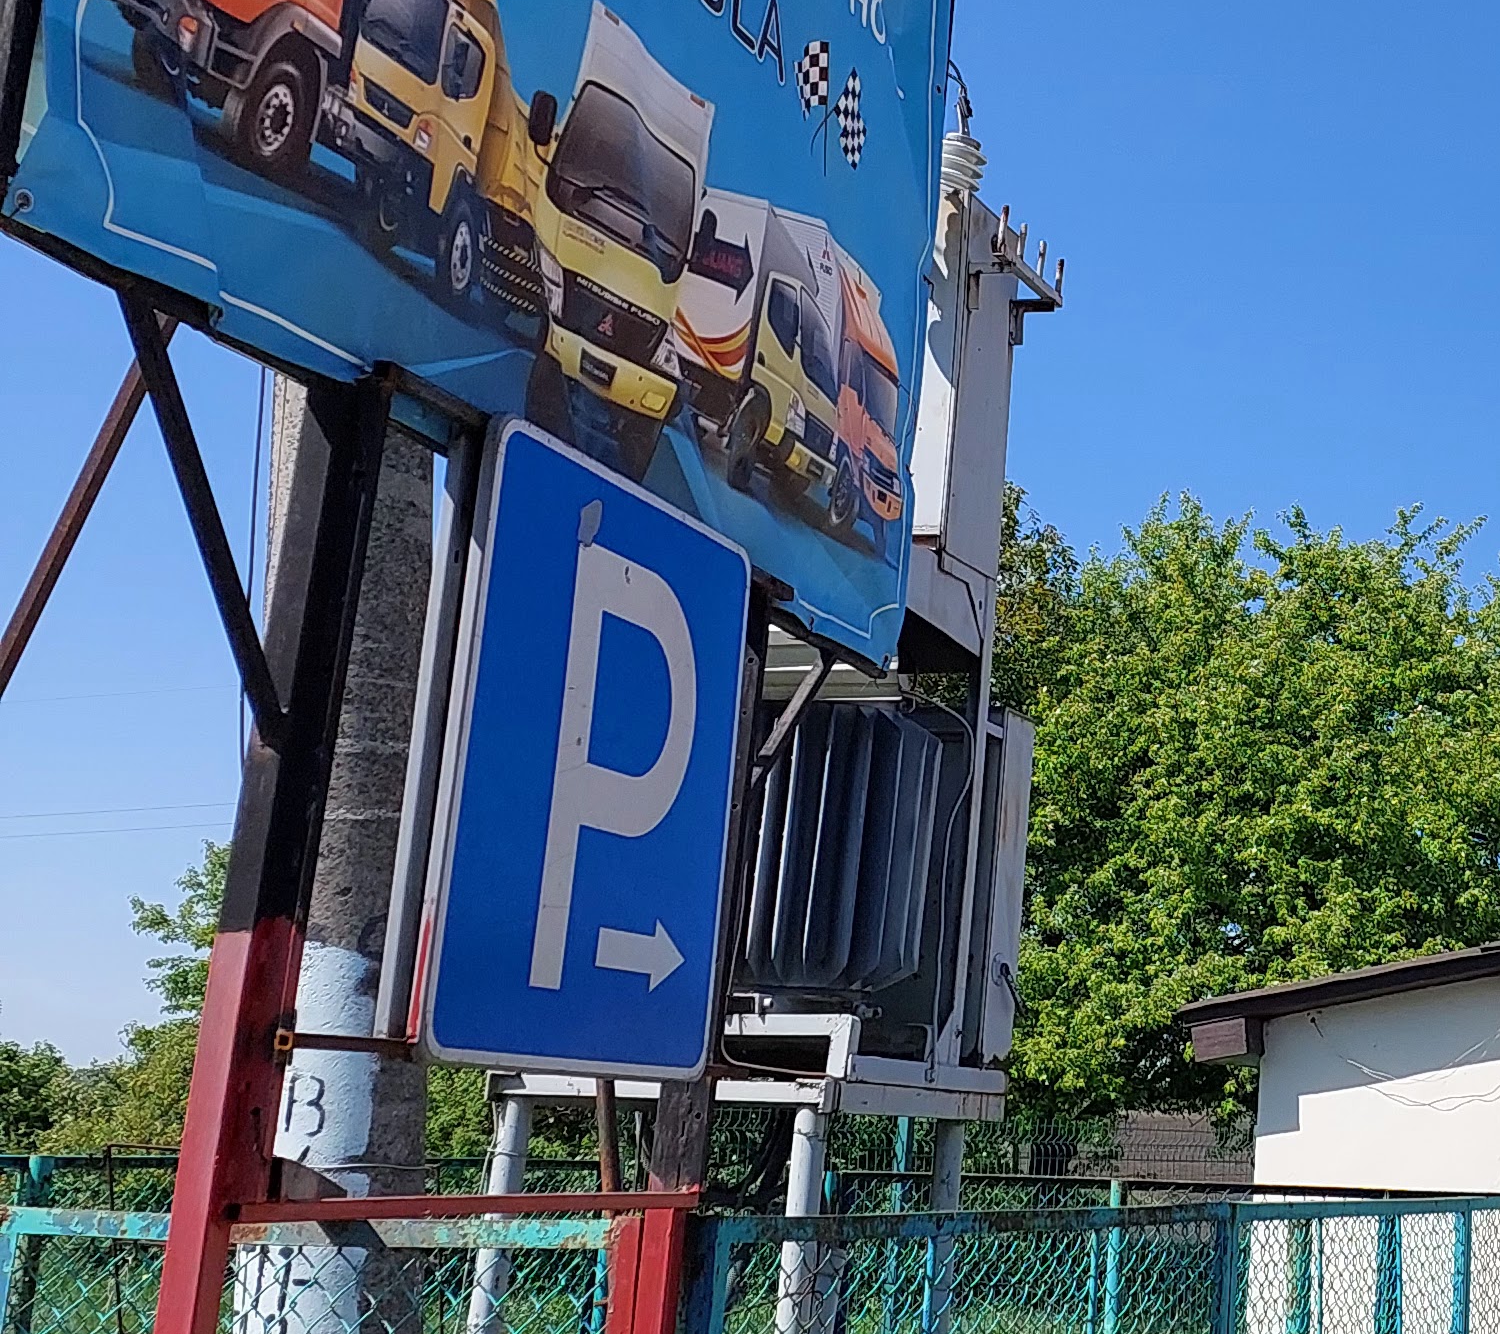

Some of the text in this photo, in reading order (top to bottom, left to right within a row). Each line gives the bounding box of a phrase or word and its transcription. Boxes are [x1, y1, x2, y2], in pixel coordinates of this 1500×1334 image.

[576, 275, 661, 327] MITSUBISHI FUSO
[528, 541, 698, 992] P
